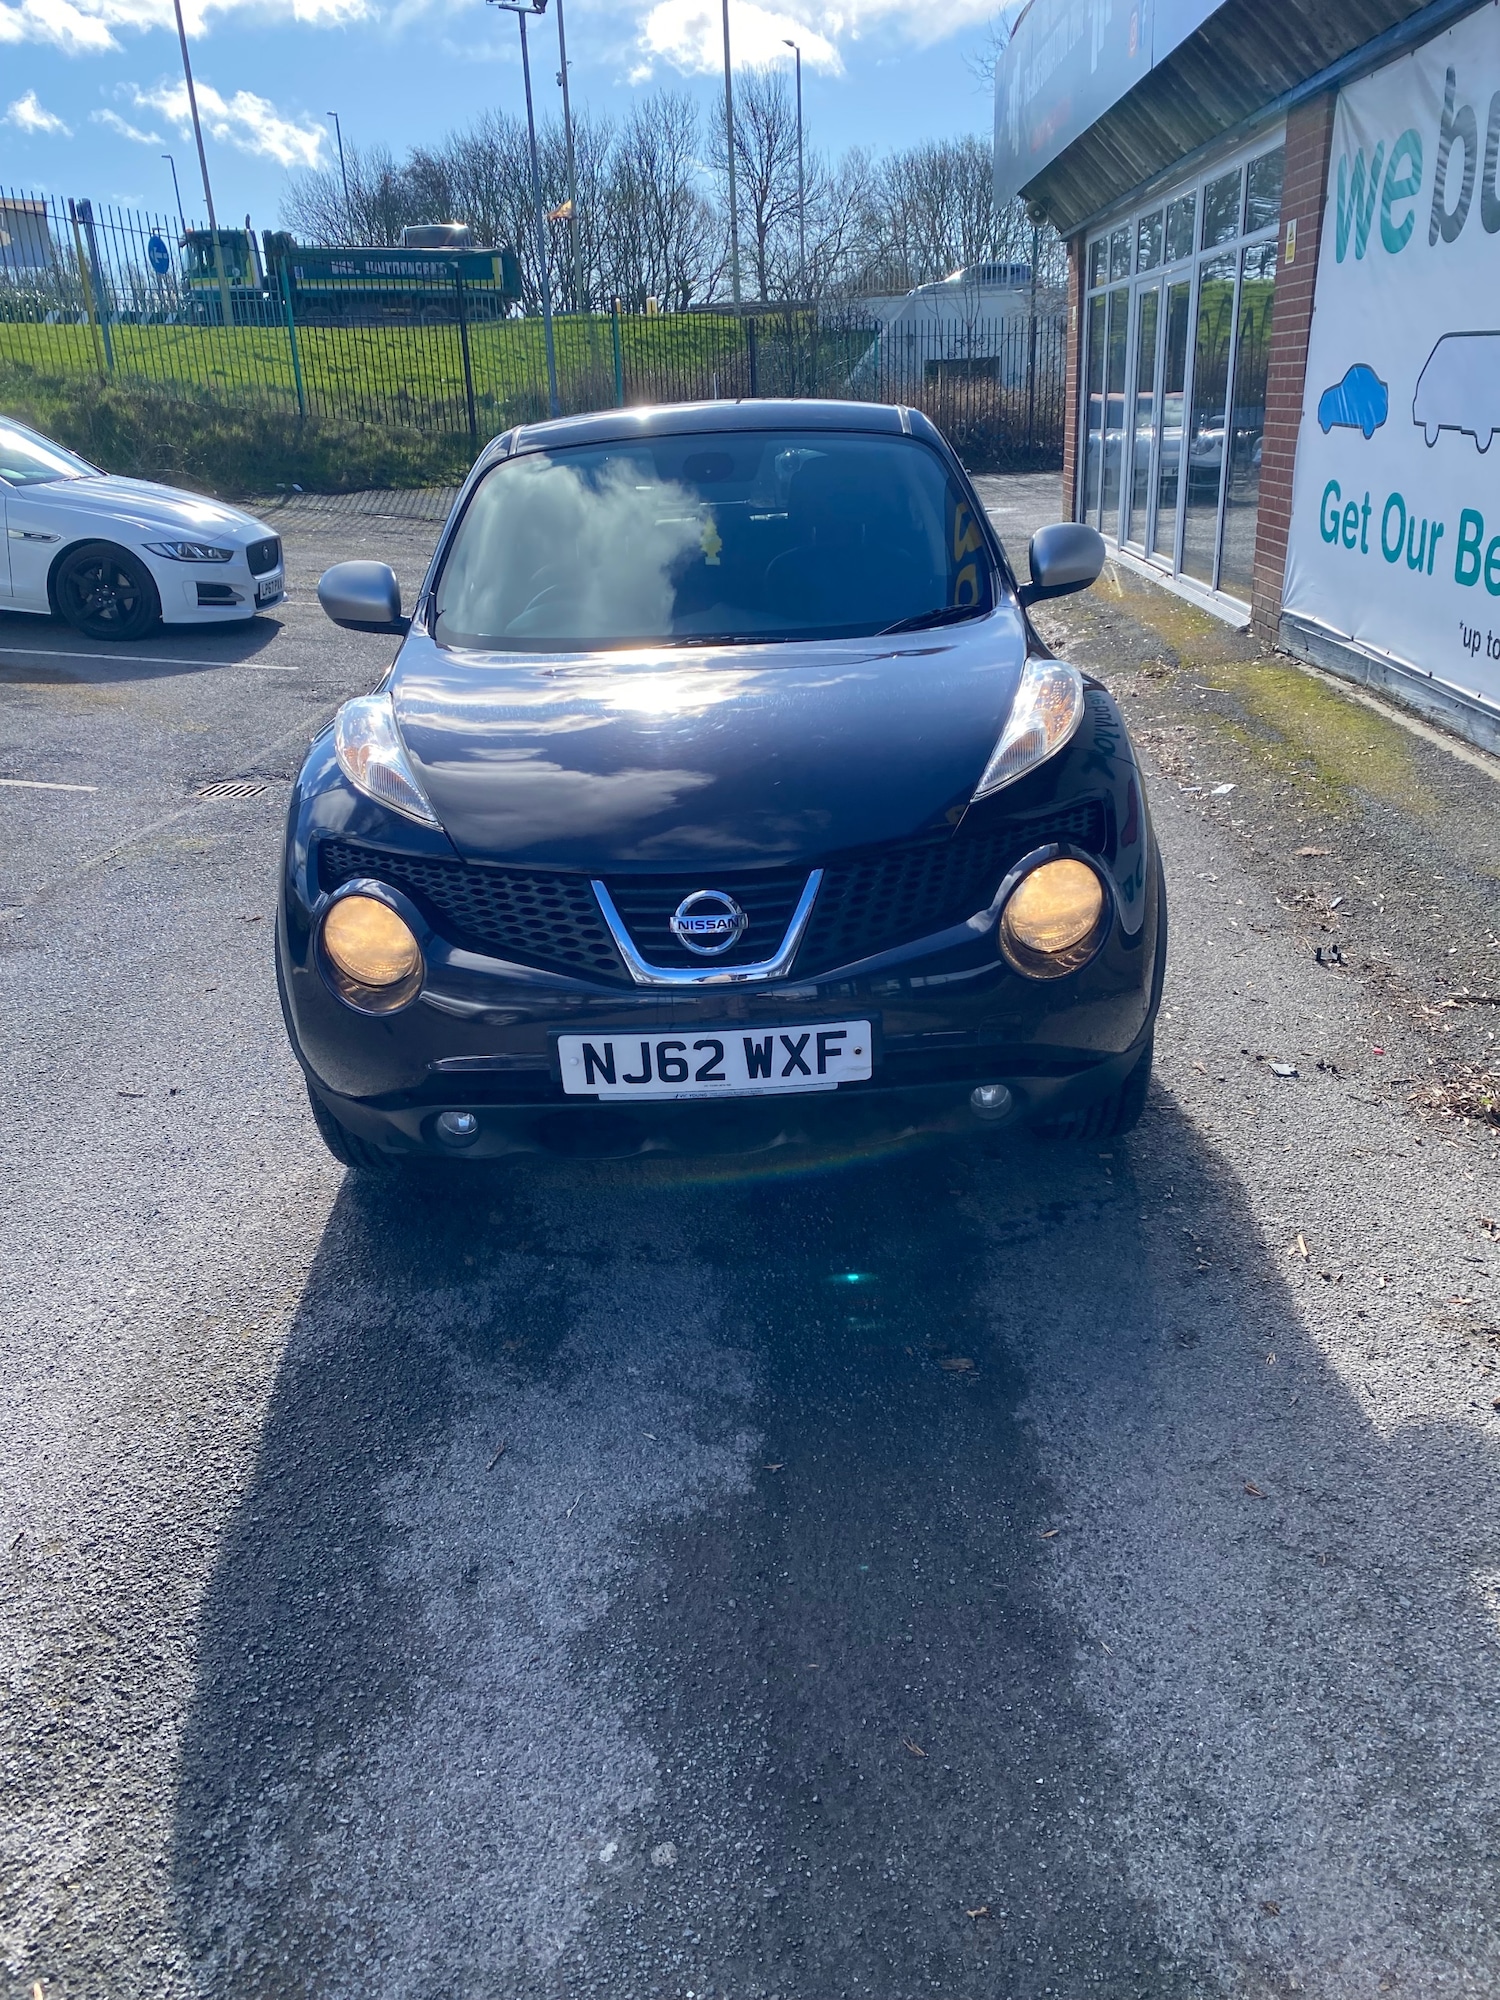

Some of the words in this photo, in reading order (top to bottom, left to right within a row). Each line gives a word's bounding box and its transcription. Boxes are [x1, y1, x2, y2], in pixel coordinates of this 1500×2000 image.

[1319, 479, 1372, 555] Get
[1381, 492, 1444, 576] Our
[1454, 508, 1500, 597] Be
[1487, 629, 1500, 660] to
[678, 916, 740, 930] NISSAN
[582, 1039, 726, 1085] NJ62
[743, 1030, 847, 1079] WXF
